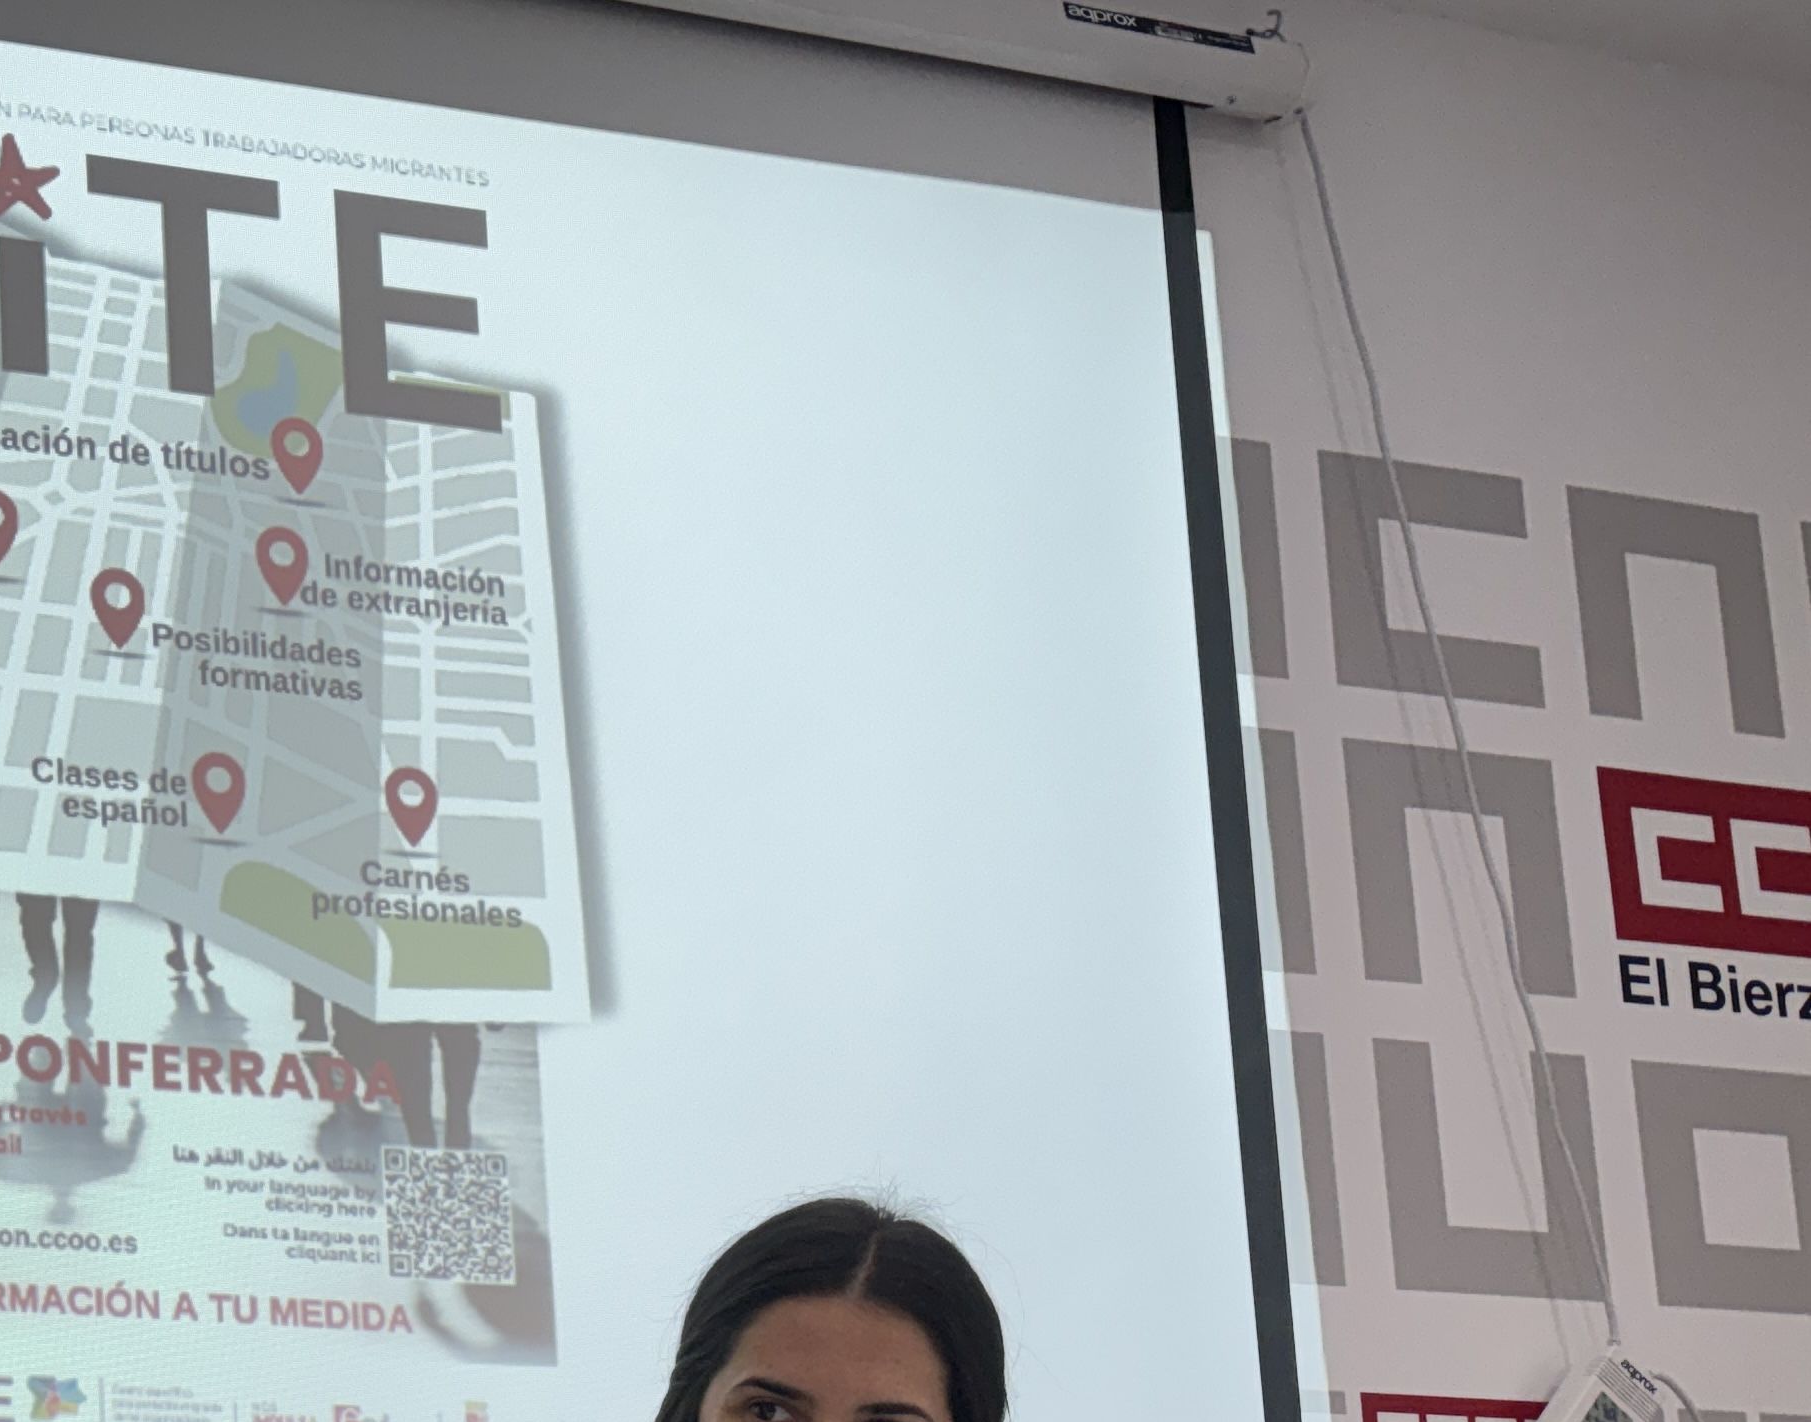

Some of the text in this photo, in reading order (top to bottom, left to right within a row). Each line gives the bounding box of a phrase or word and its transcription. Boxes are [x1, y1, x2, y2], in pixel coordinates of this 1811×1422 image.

[17, 104, 74, 127] PARA
[81, 113, 195, 144] PERSONAS
[202, 128, 367, 168] TRABAJADORAS
[371, 156, 490, 187] MIGRANTES
[108, 434, 150, 468] de
[160, 438, 270, 481] títulos
[324, 552, 505, 597] Información
[300, 580, 508, 626] de extranjería
[152, 622, 361, 668] Posibilidades
[199, 661, 363, 701] formativas
[31, 756, 187, 795] Clases de
[62, 792, 188, 829] español
[360, 859, 470, 894] Carnés
[312, 889, 523, 930] profesionales
[1618, 954, 1669, 1007] El
[6, 1103, 88, 1127] través
[172, 1143, 200, 1163] هنا
[293, 1153, 320, 1173] من
[204, 1176, 376, 1203] In your language by
[264, 1198, 376, 1218] clicking here
[222, 1223, 268, 1240] Dans
[292, 1225, 354, 1246] langue
[357, 1233, 380, 1247] en
[172, 1291, 201, 1323] A
[207, 1292, 260, 1327] TU
[269, 1296, 414, 1335] MEDIDA
